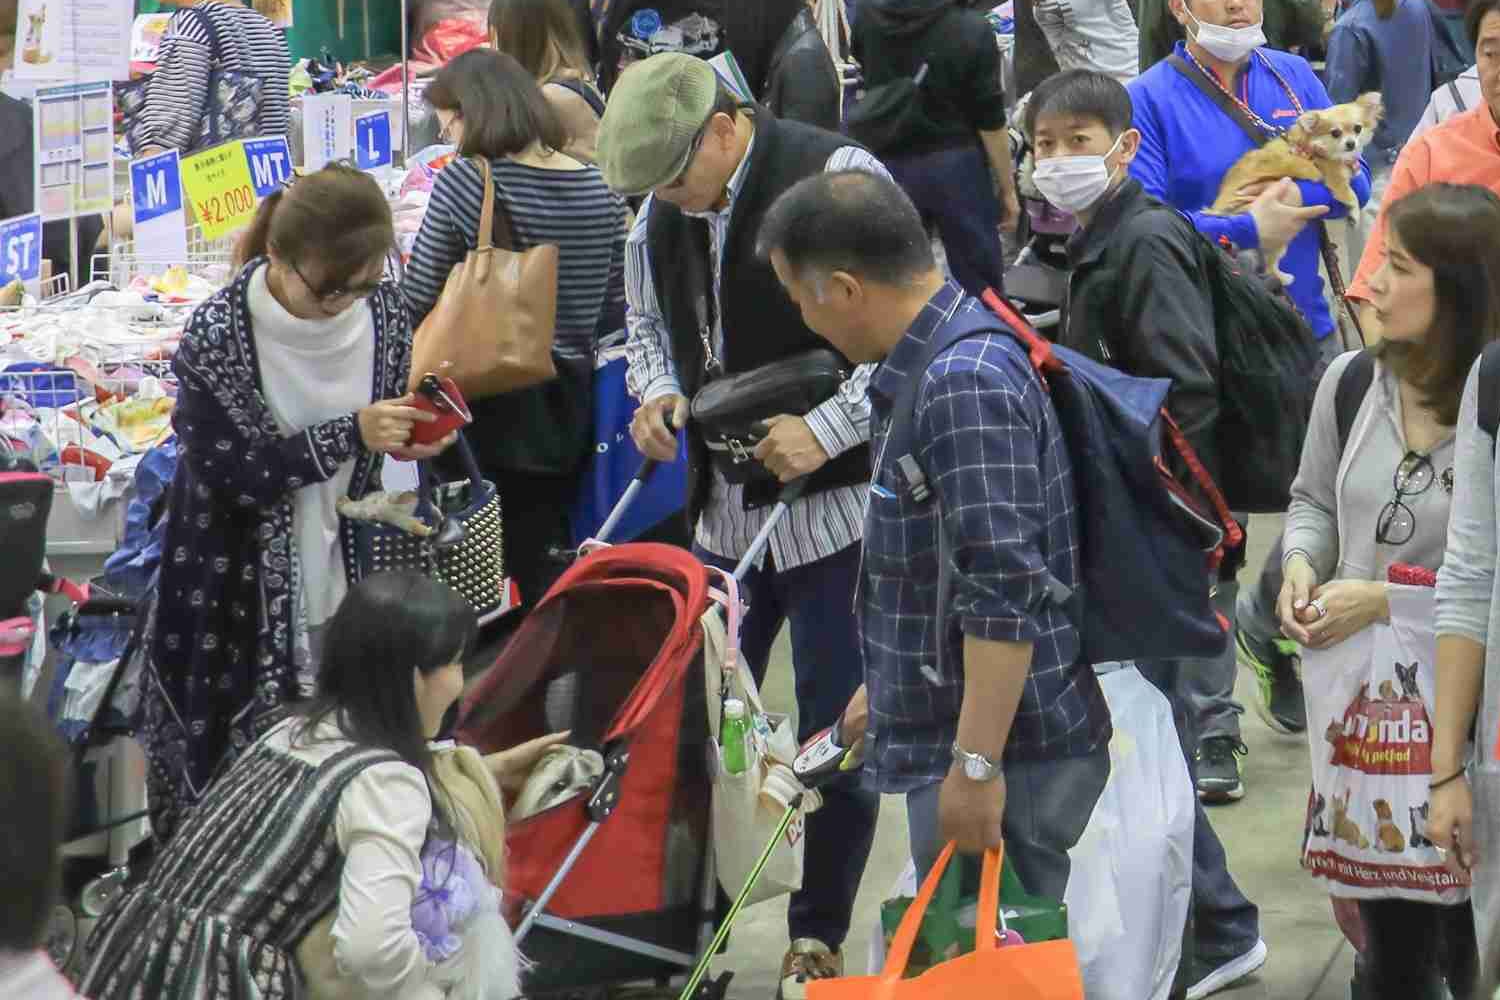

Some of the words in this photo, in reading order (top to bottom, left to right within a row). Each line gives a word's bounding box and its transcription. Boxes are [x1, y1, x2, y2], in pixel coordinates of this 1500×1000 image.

[368, 127, 380, 160] L
[252, 152, 284, 187] MT
[146, 169, 168, 209] M
[197, 185, 253, 224] ¥2,000
[6, 232, 34, 274] ST
[1383, 867, 1407, 881] und
